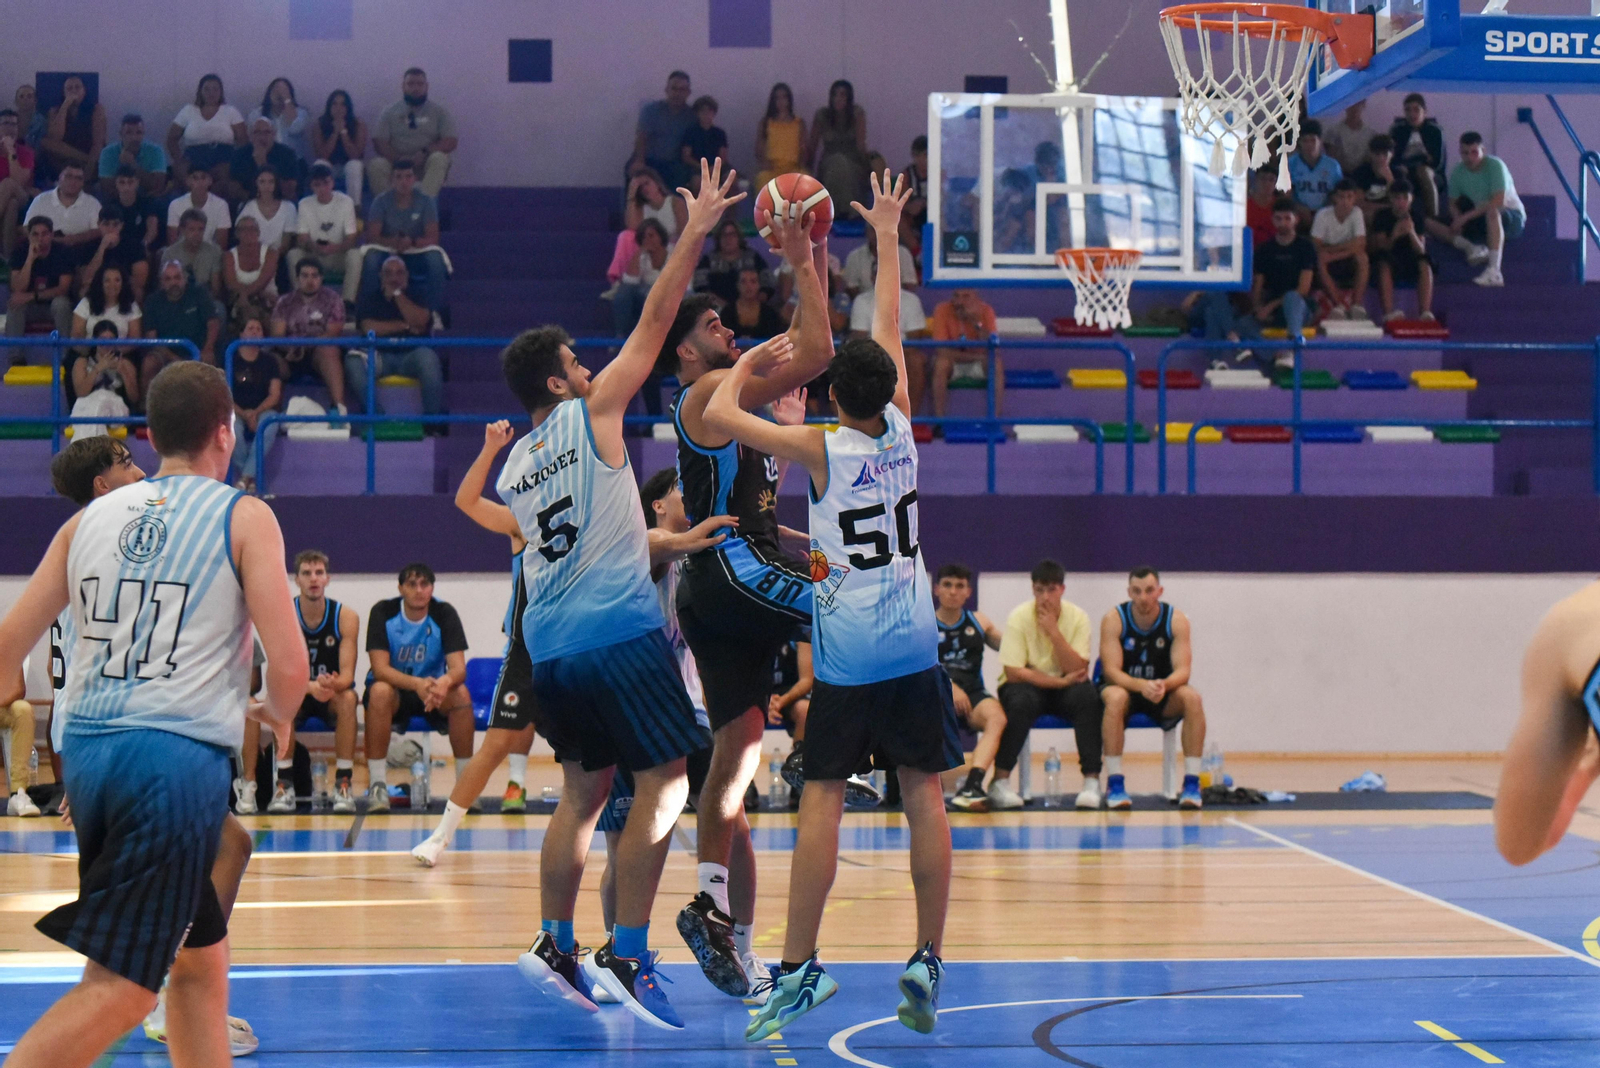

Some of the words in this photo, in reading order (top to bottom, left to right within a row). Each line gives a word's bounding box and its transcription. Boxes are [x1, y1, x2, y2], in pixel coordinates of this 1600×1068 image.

[874, 454, 912, 477] ACUOS
[536, 494, 579, 563] 5
[838, 489, 919, 571] 50
[756, 570, 804, 606] ULB
[80, 576, 190, 680] 41
